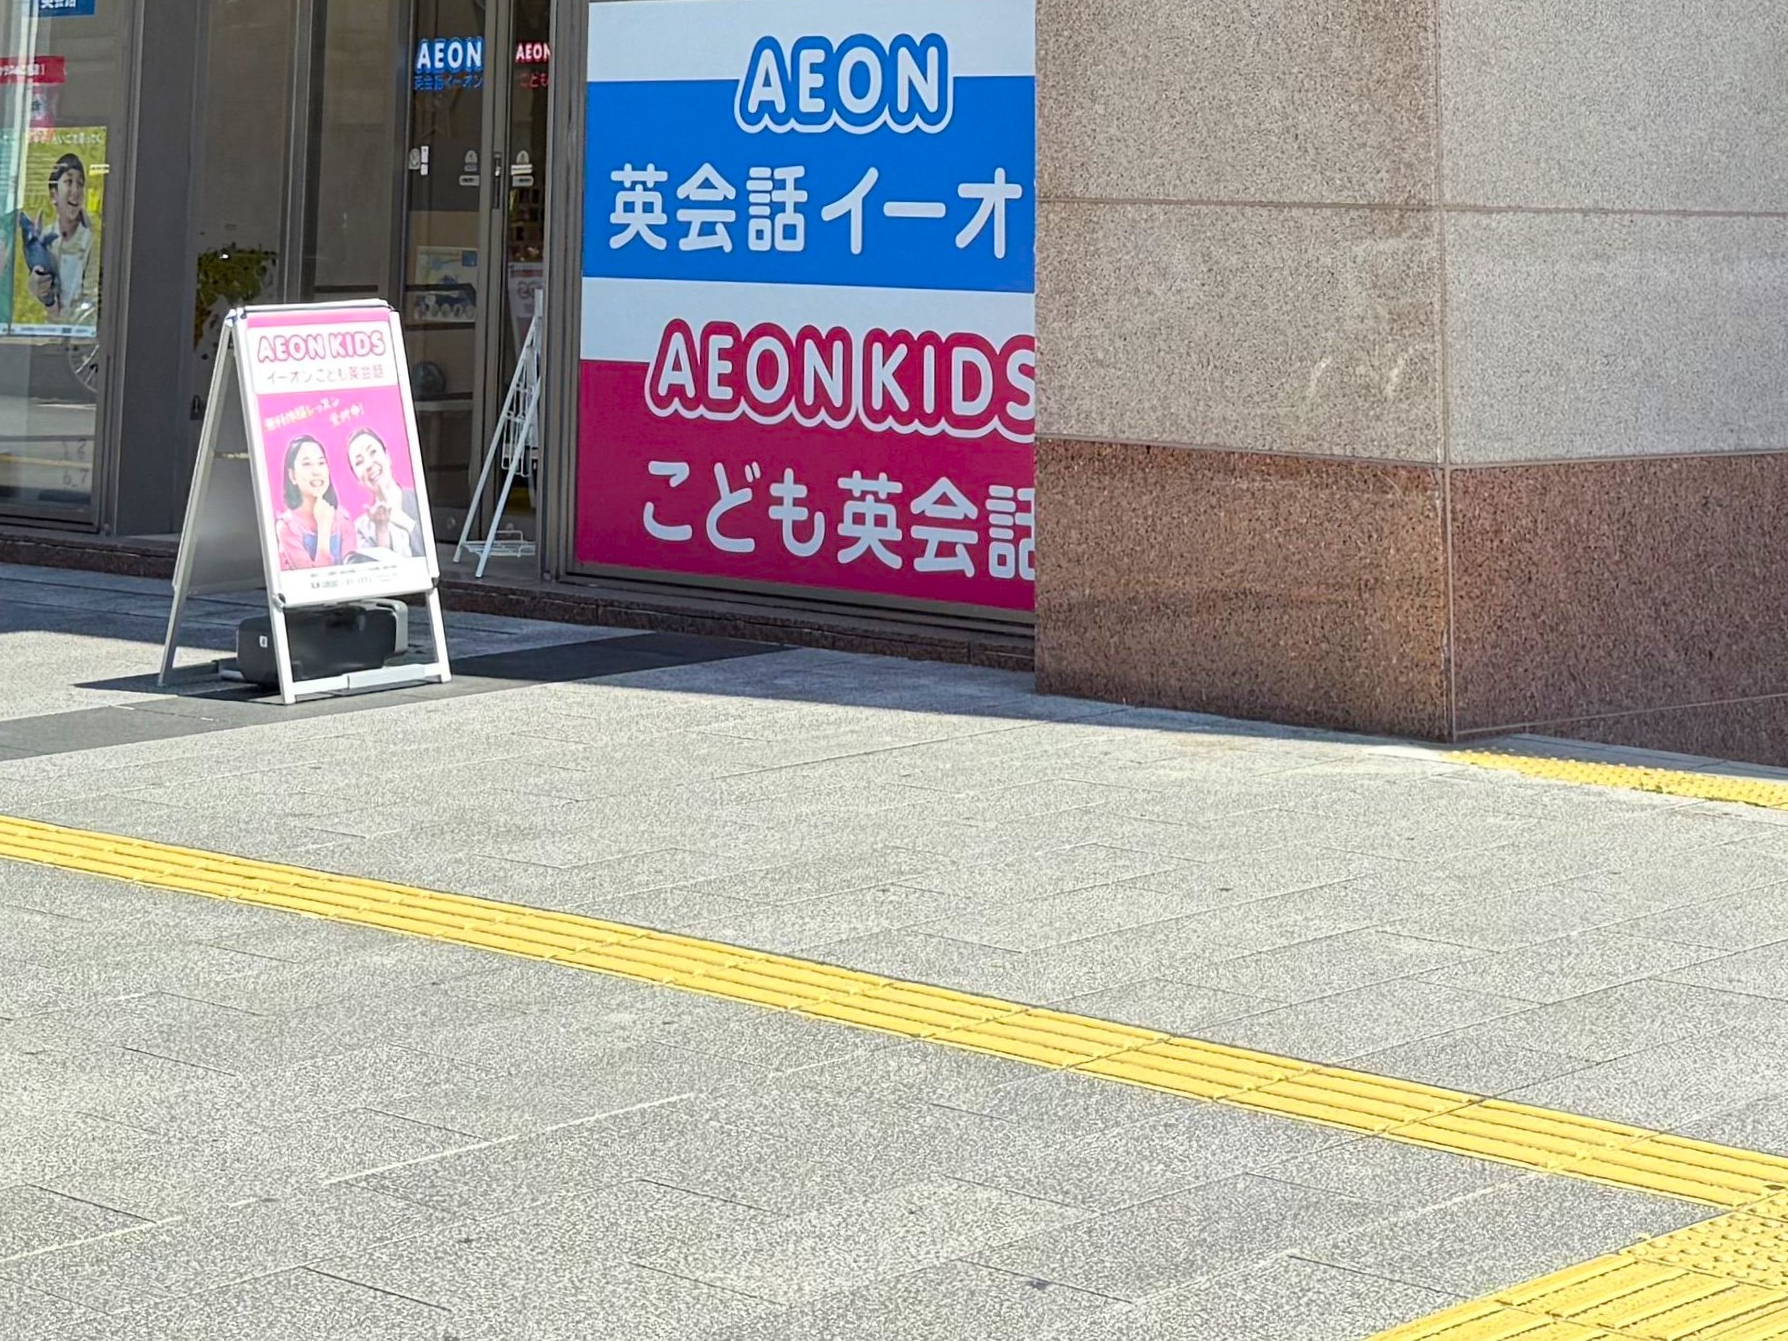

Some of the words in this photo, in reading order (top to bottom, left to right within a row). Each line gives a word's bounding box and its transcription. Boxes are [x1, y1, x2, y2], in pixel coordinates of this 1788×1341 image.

[416, 39, 483, 71] AEON
[742, 39, 946, 123] AEON
[608, 161, 1024, 260] 英会話イーオ
[258, 334, 327, 363] AEON
[328, 330, 386, 358] KIDS
[652, 325, 851, 416] AEON
[866, 335, 1036, 430] KIDS
[643, 461, 1036, 582] こども英会話
